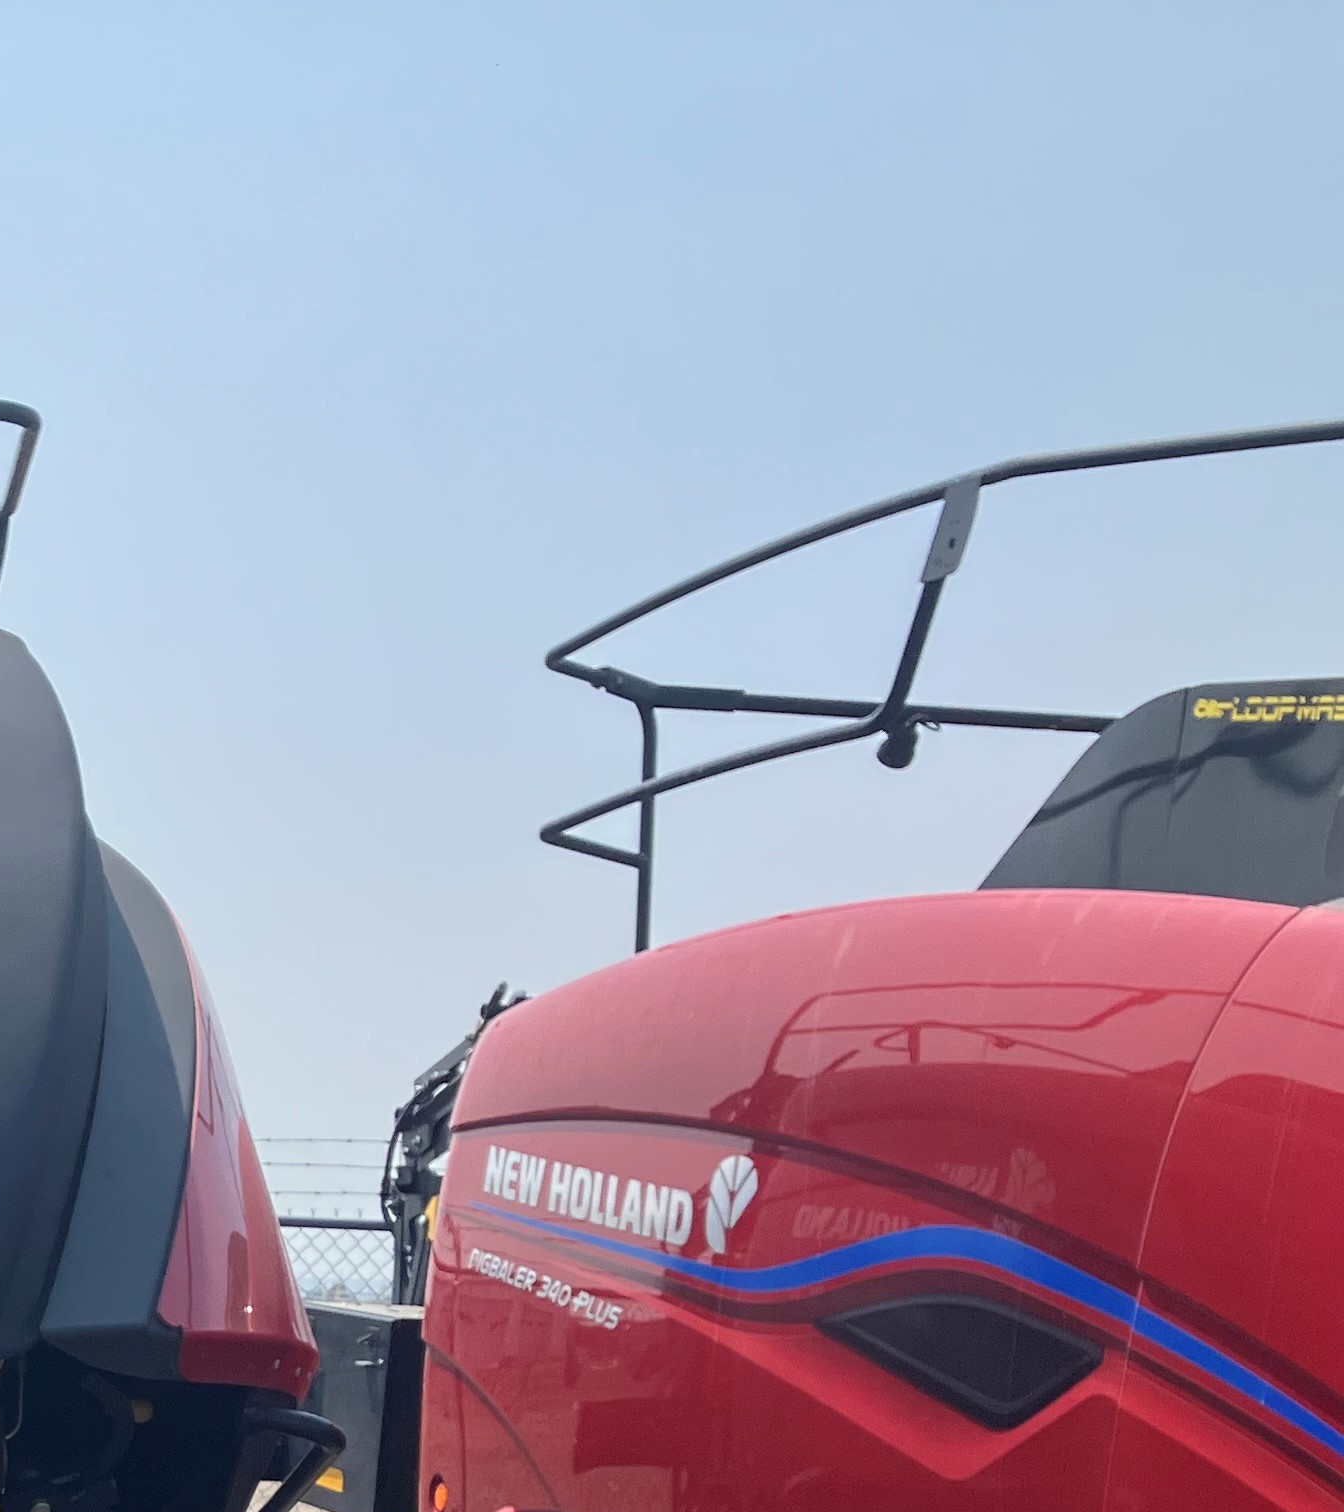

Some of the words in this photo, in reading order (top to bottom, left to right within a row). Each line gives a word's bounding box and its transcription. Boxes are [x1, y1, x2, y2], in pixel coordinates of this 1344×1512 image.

[483, 1144, 546, 1207] NEW
[548, 1161, 694, 1247] HOLLAND
[468, 1247, 537, 1292] BIGBALER
[536, 1274, 573, 1308] 340
[573, 1290, 624, 1331] PLUS
